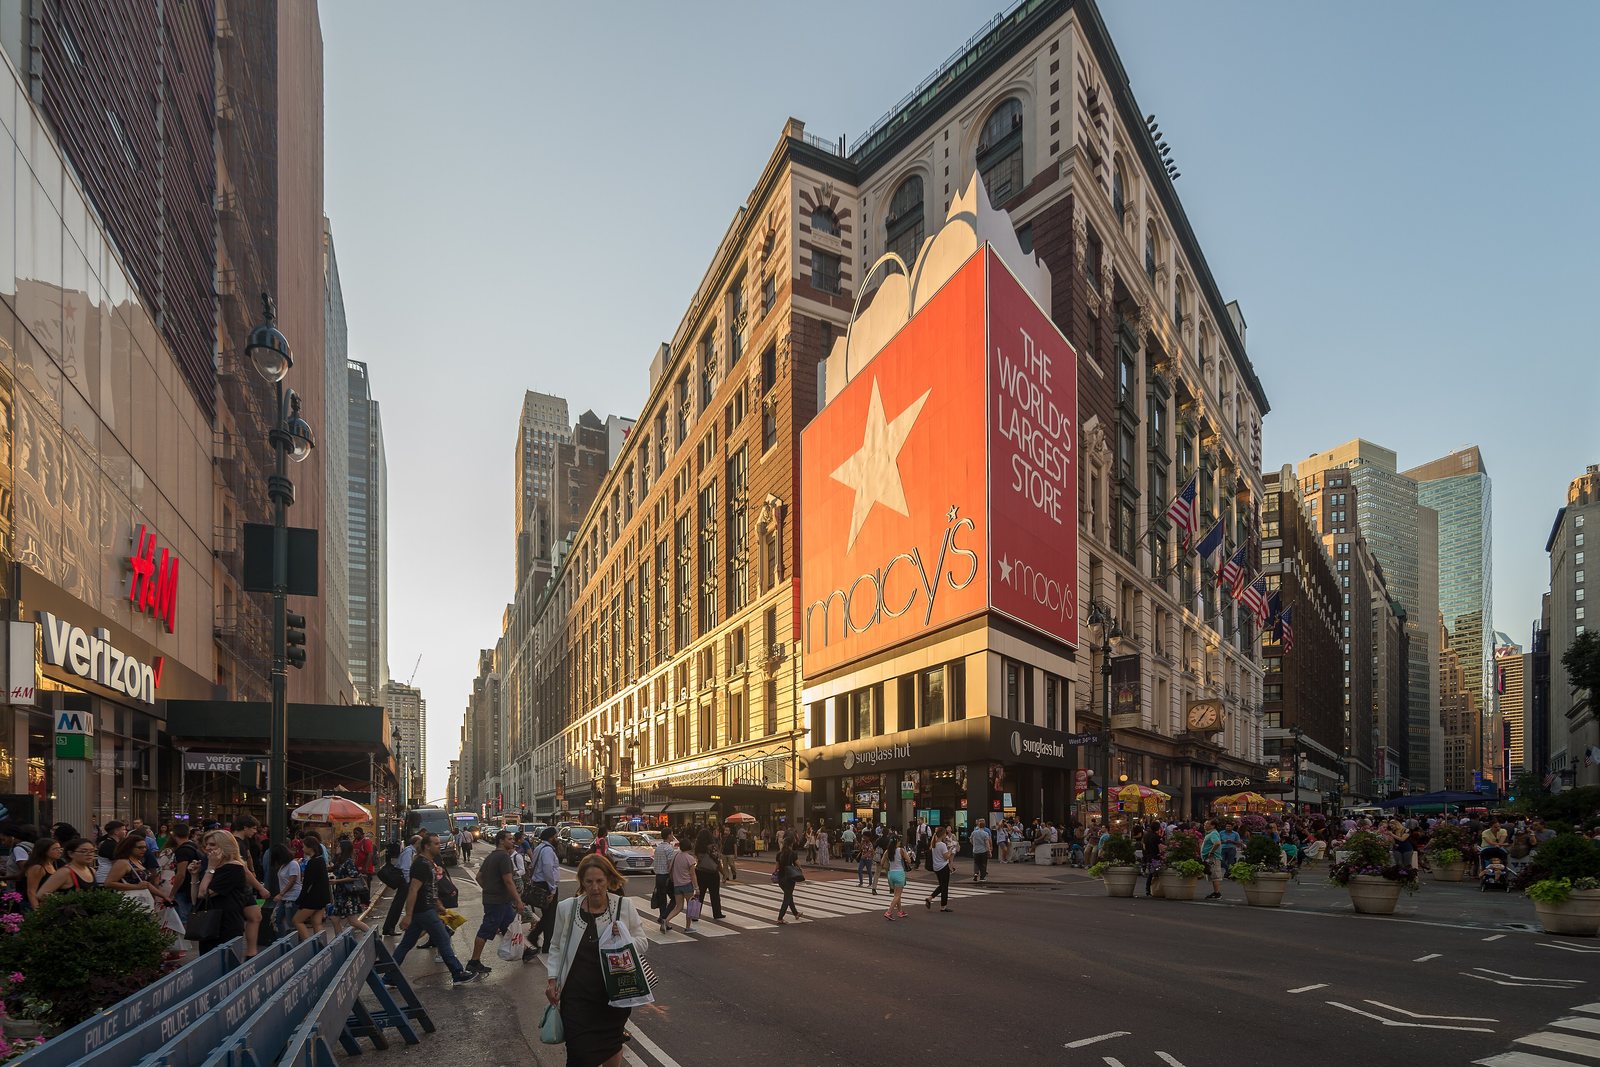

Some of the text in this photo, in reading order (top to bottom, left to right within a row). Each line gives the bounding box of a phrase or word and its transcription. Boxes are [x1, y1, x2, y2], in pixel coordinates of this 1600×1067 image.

[1019, 327, 1052, 394] THE
[997, 347, 1071, 452] WORLD'S
[999, 394, 1070, 488] LARGEST
[1012, 454, 1062, 525] STORE
[806, 505, 978, 654] macy's
[1014, 557, 1074, 623] macy's
[43, 611, 155, 705] verizon
[187, 762, 206, 770] WE
[208, 763, 233, 771] ARE
[206, 754, 243, 763] verizon
[855, 742, 911, 766] sunglass hut
[1022, 737, 1064, 759] sunglass hut
[84, 1014, 119, 1054] POLICE
[125, 1000, 143, 1027] LINE
[153, 988, 162, 1009] DO
[163, 981, 175, 1003] NOT
[176, 969, 194, 993] CROSS
[160, 1005, 190, 1043] POLICE
[194, 992, 211, 1019] LINE
[225, 995, 247, 1031] POLICE
[284, 985, 299, 1017] POLICE
